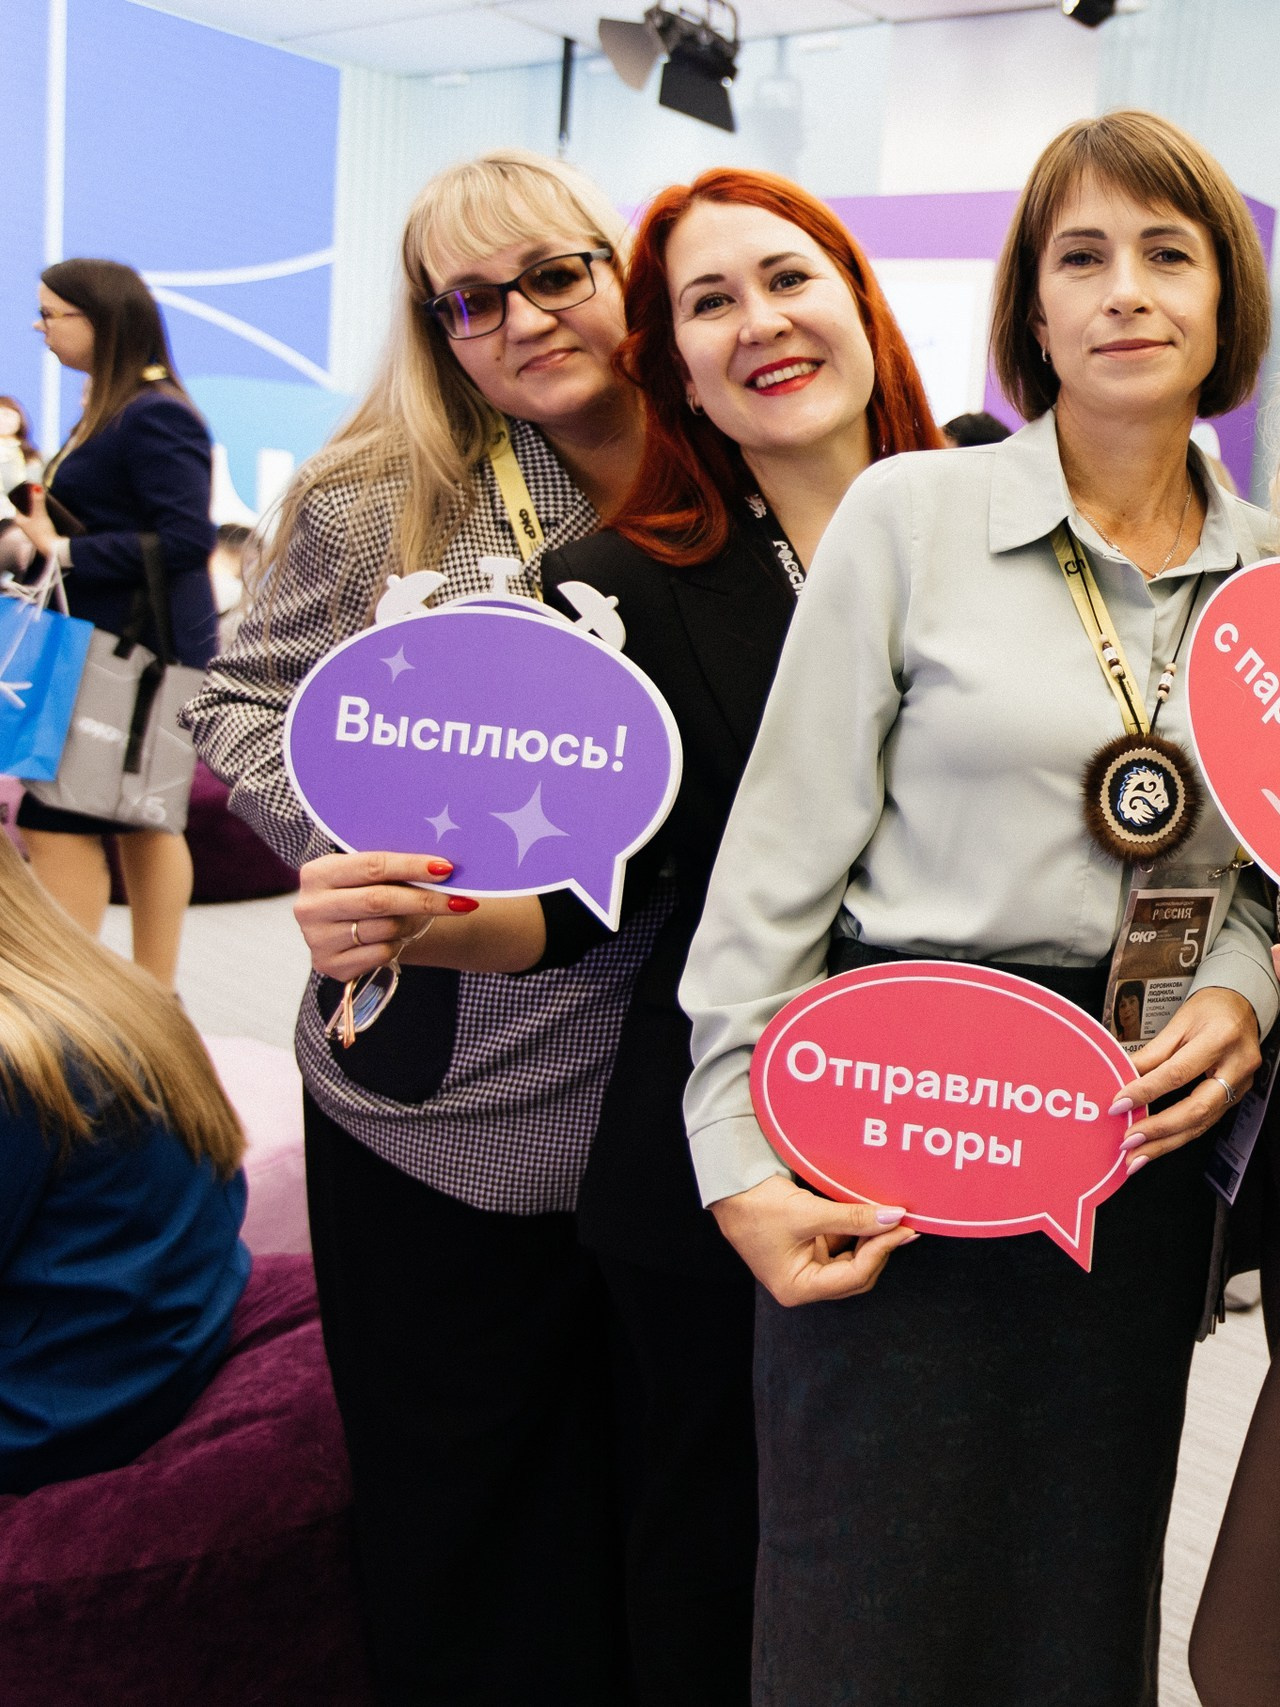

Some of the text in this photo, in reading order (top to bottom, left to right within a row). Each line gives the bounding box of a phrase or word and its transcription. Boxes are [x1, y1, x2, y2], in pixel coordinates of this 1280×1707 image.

[519, 508, 536, 539] ФКР
[1214, 623, 1239, 653] с
[335, 695, 627, 772] Высплюсь!
[1129, 931, 1157, 943] ФКР
[1179, 928, 1199, 967] 5
[786, 1040, 1100, 1123] Отправлюсь
[864, 1117, 1022, 1170] в горы
